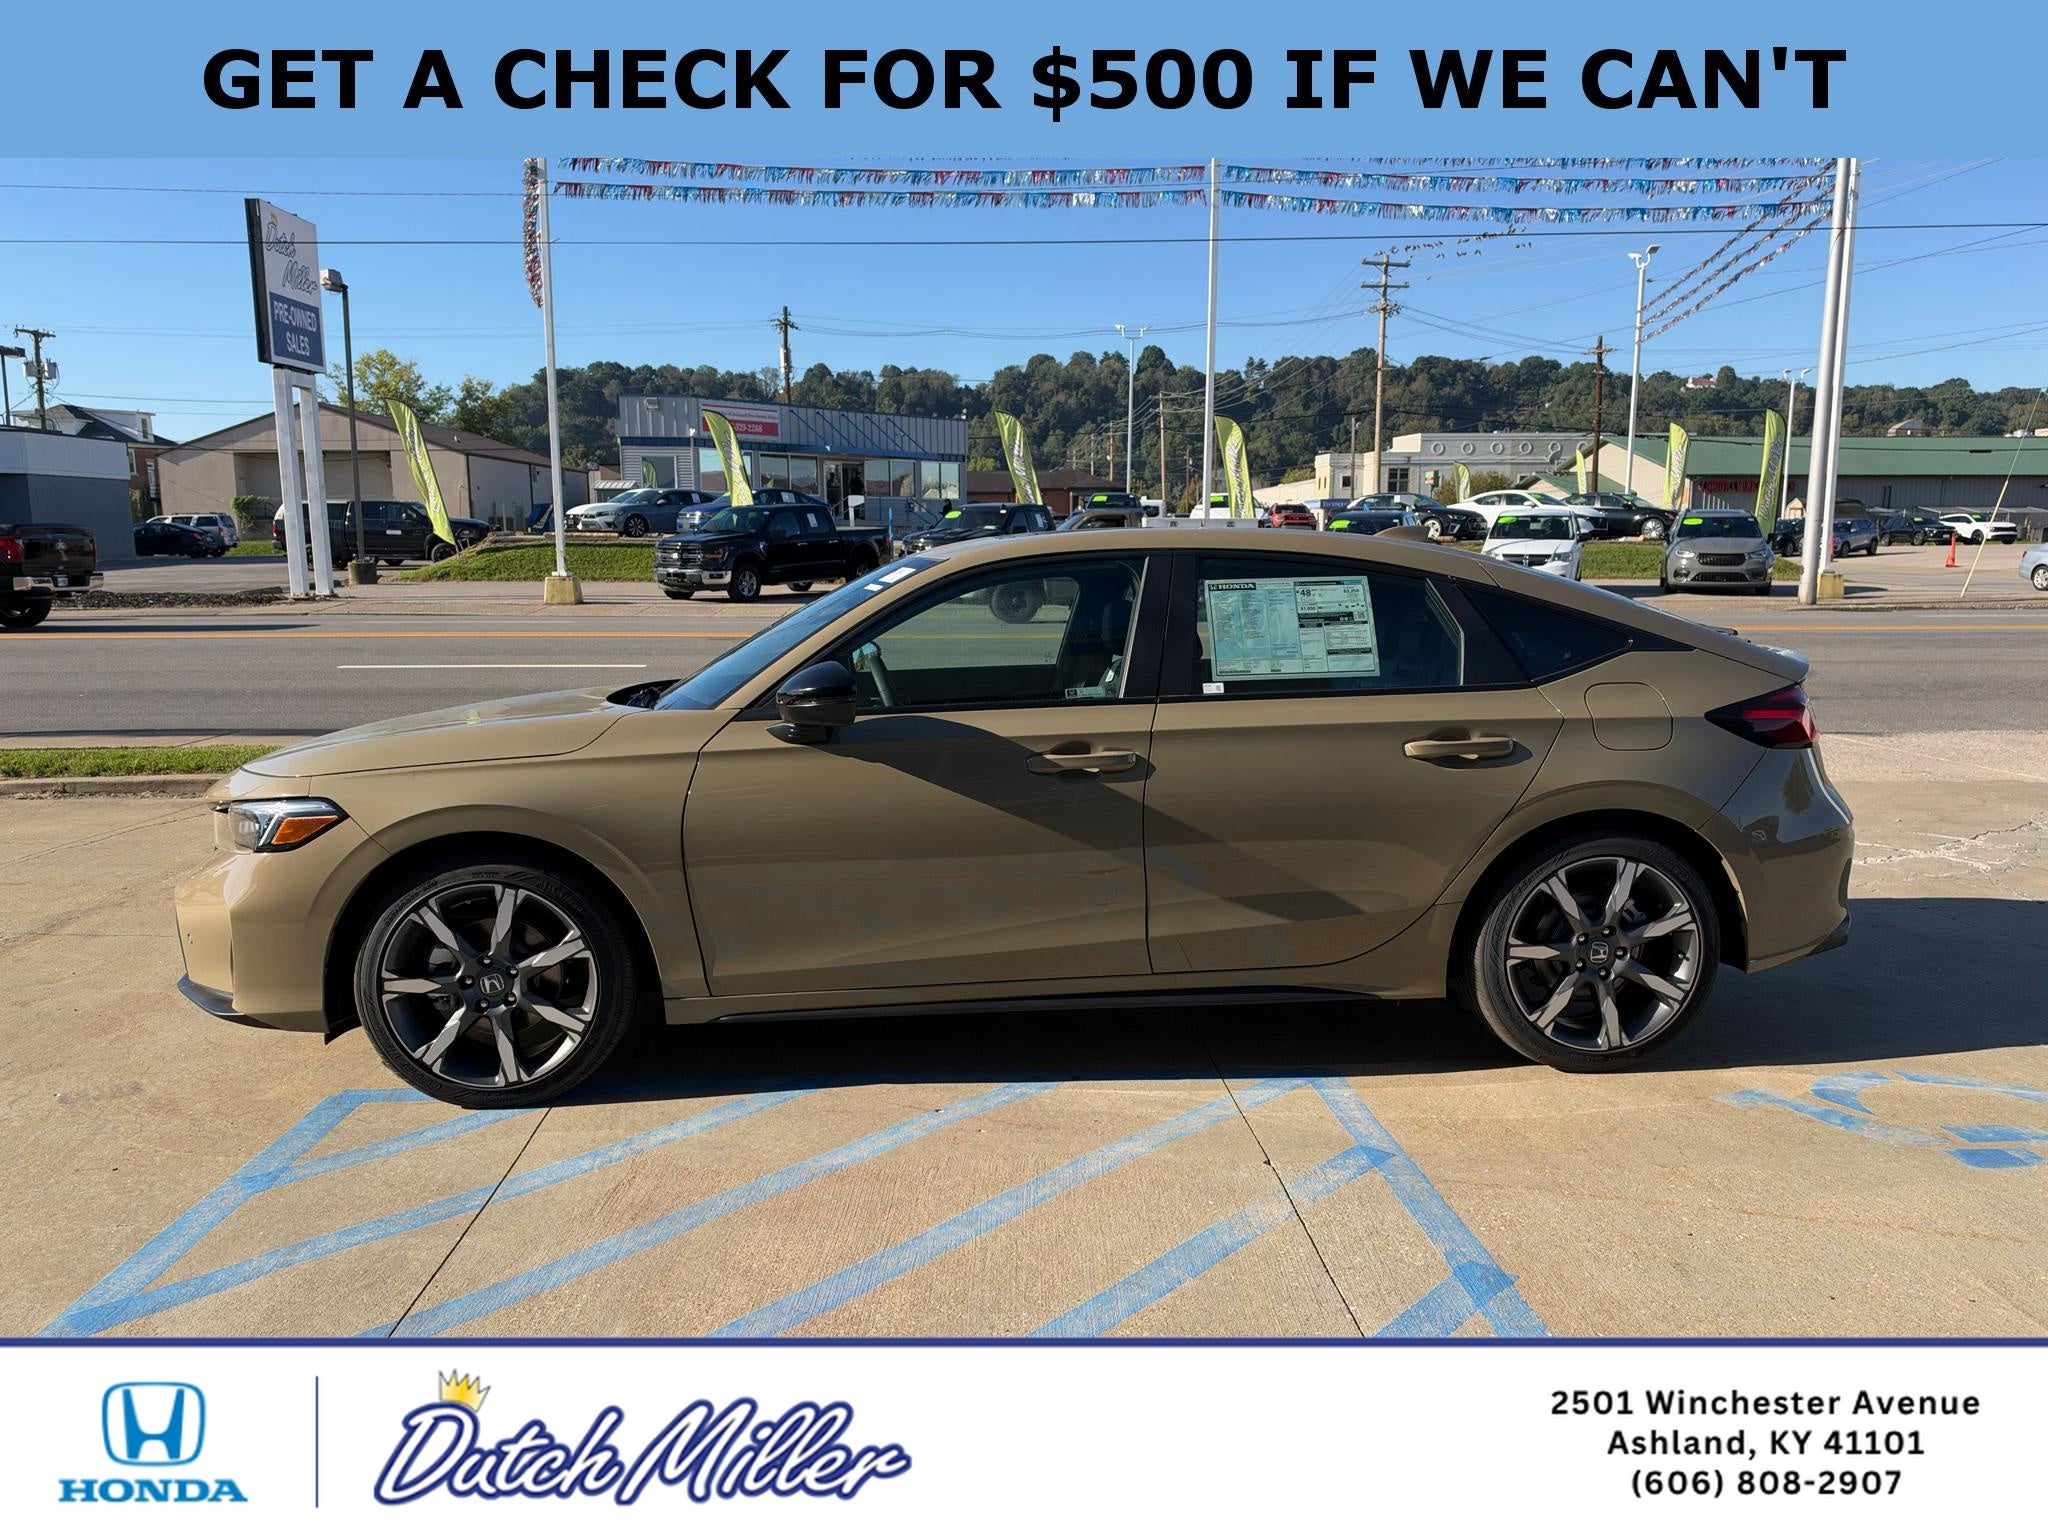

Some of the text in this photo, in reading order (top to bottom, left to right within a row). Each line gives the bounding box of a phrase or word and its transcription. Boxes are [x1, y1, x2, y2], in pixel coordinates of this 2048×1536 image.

[265, 222, 297, 258] Dutch
[281, 260, 318, 295] Miller
[273, 300, 317, 332] PRE-OWNED
[285, 334, 310, 356] SALES
[1300, 589, 1312, 597] 48
